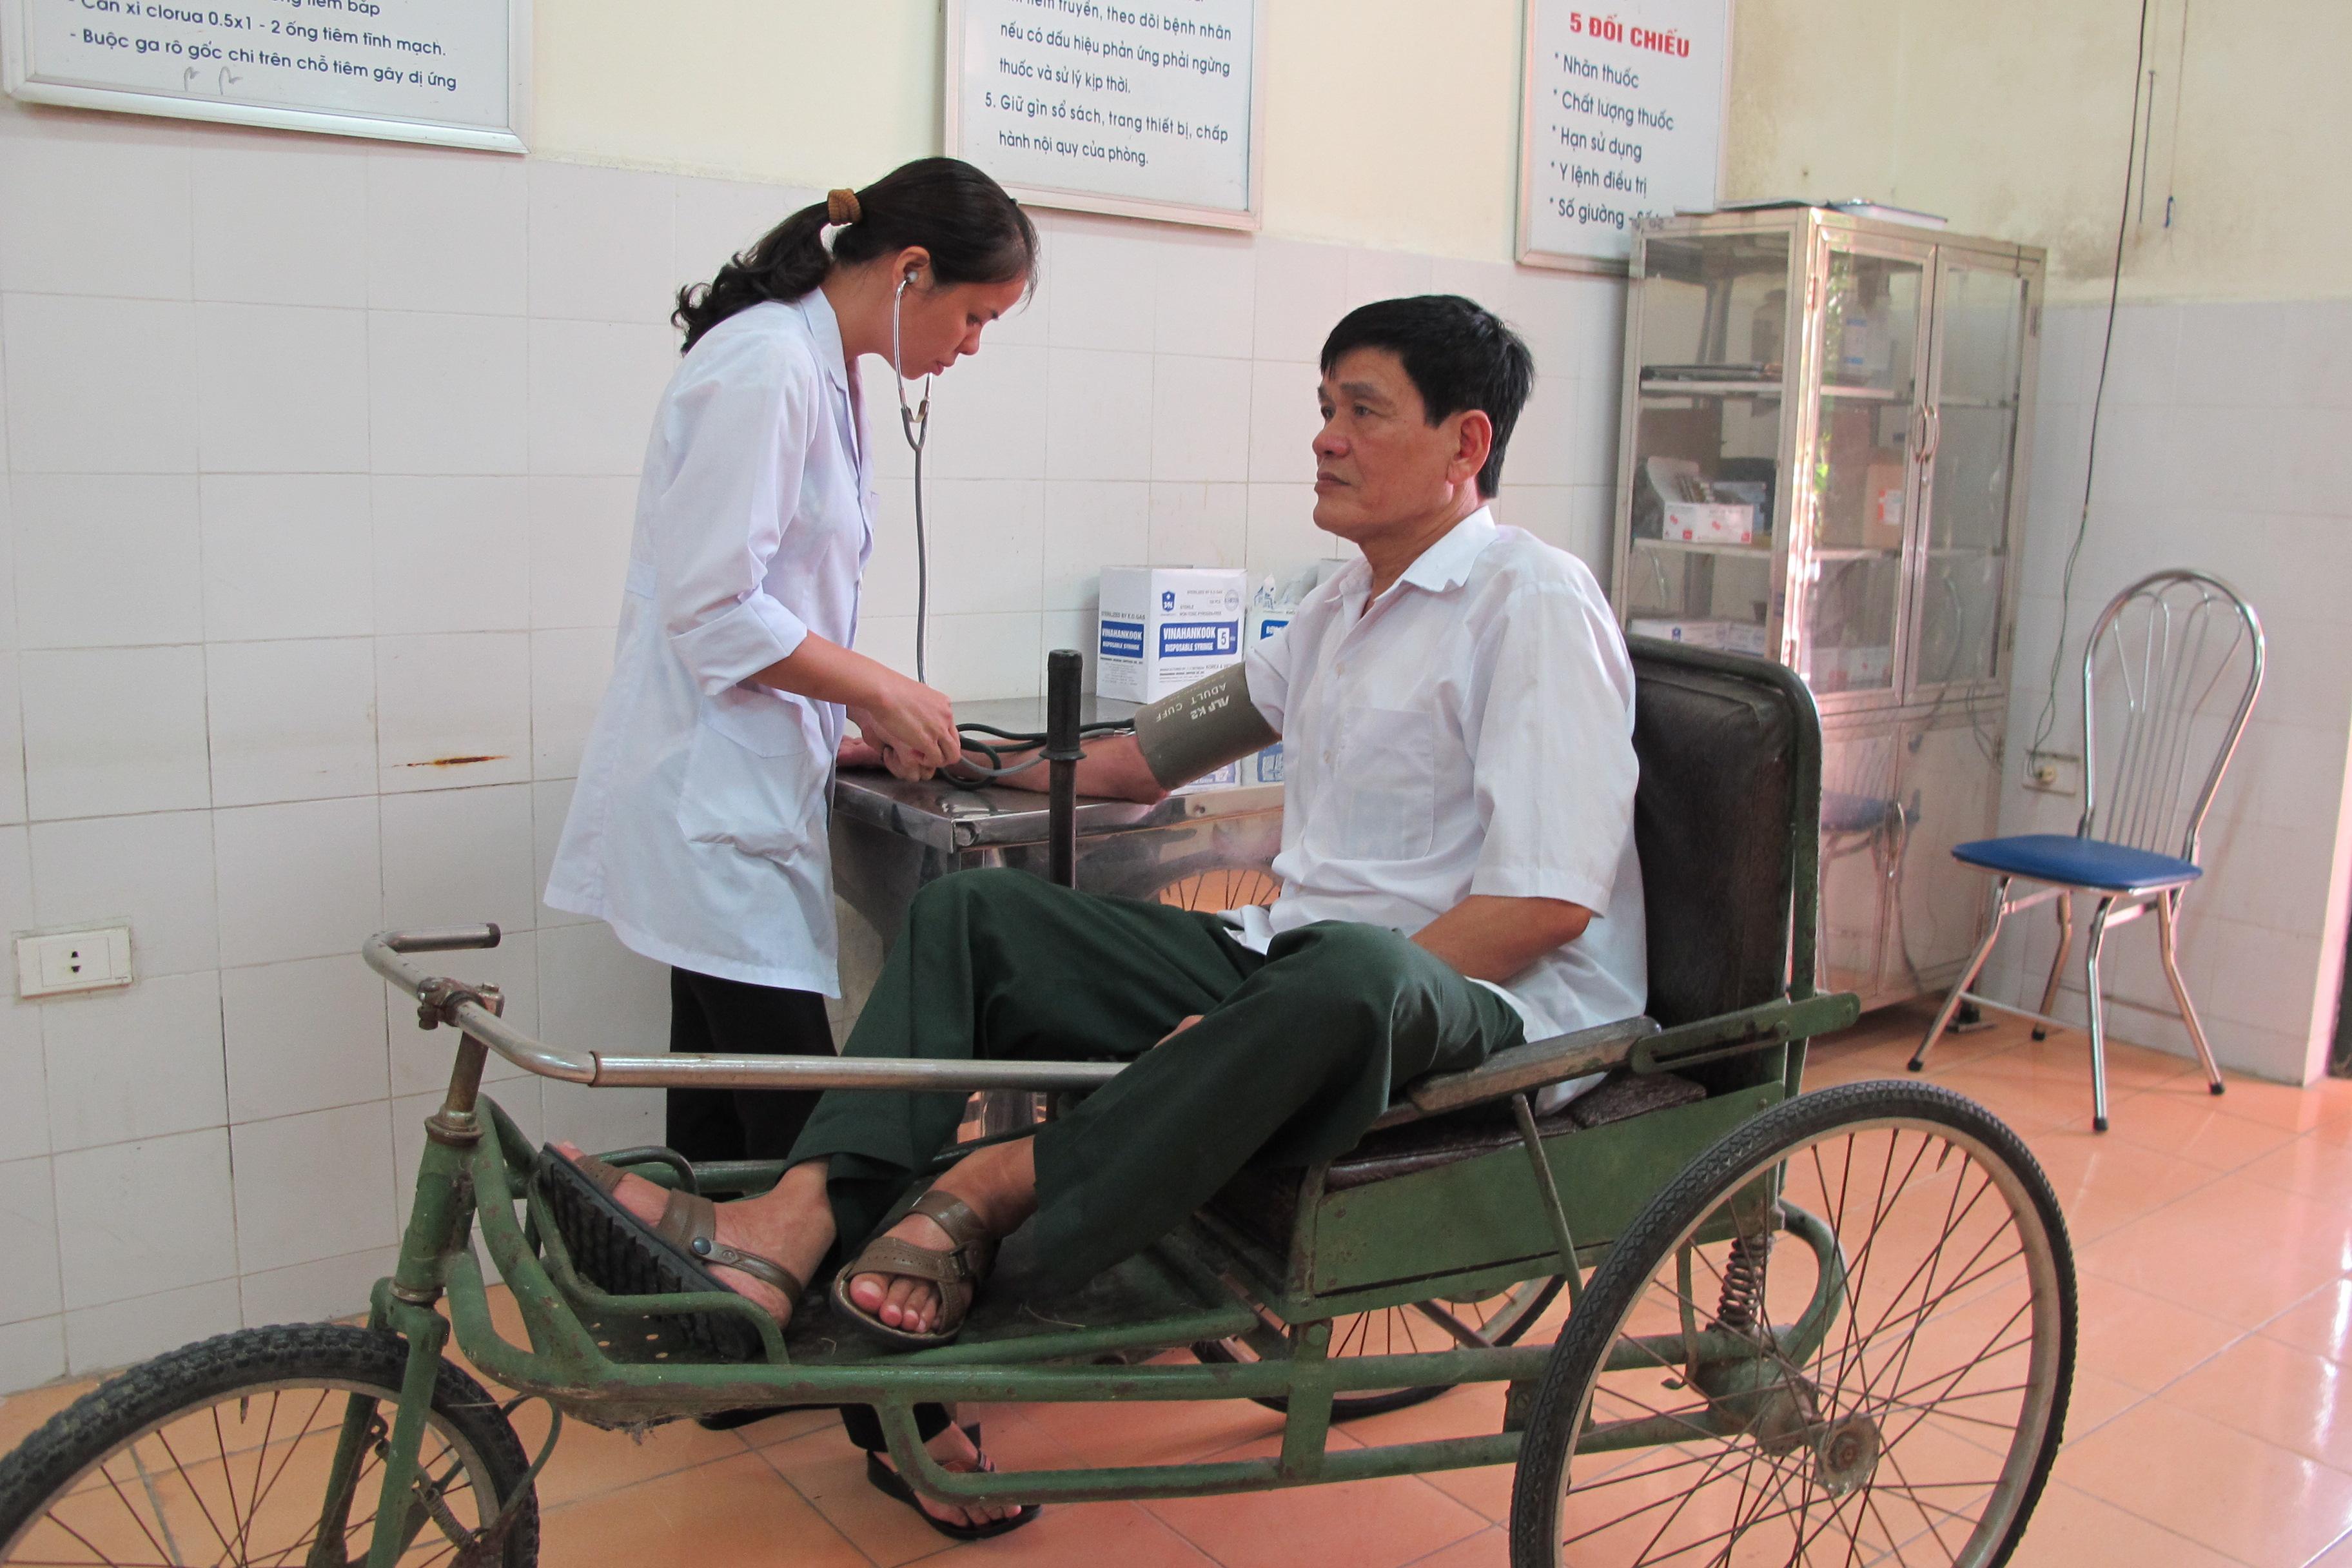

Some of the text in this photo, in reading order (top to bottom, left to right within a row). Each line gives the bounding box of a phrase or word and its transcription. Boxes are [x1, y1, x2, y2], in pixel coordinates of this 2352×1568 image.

[126, 1, 140, 15] xi
[146, 5, 203, 23] clorua
[208, 12, 251, 30] 0.5x1
[271, 20, 280, 34] 2
[286, 21, 318, 41] ống
[323, 27, 358, 44] tiêm
[363, 32, 391, 48] tĩnh
[397, 41, 446, 56] mạch.
[1107, 6, 1135, 24] theo
[1140, 13, 1159, 29] dõi
[1164, 16, 1195, 35] bệnh
[1200, 24, 1231, 41] nhân
[1570, 12, 1689, 57] 5 ĐỐI CHIẾU
[83, 28, 129, 50] Buộc
[135, 39, 159, 54] ga
[166, 40, 182, 55] rô
[188, 41, 222, 59] gốc
[229, 49, 253, 63] chi
[259, 51, 291, 68] trên
[334, 60, 368, 77] tiêm
[373, 67, 403, 84] gây
[409, 70, 423, 88] dị
[428, 72, 456, 91] ứng
[1001, 21, 1230, 77] nếu có dấu hiệu phản ứng phải ngừng
[1000, 57, 1130, 93] thuốc và sử lý kịp thời.
[1603, 64, 1639, 88] thuốc
[985, 92, 1228, 144] 5. Giữ gìn sổ sách, trang thiết bị, chấp
[1562, 90, 1673, 130] Chất lượng thuốc
[999, 131, 1148, 167] hành nội quy của phòng.
[1561, 127, 1642, 162] Hạn sử dụng
[1560, 162, 1567, 181] Y
[1571, 166, 1599, 187] lệnh
[1636, 177, 1647, 199] trị
[1558, 198, 1574, 217] Số
[1579, 204, 1623, 230] giường
[1102, 628, 1142, 640] VINAHANKOOK
[1163, 627, 1226, 645] VINAHANKOOK 5
[1165, 643, 1193, 652] DISPOSABLE
[1191, 682, 1227, 706] ADULT
[1156, 702, 1182, 722] CUFF
